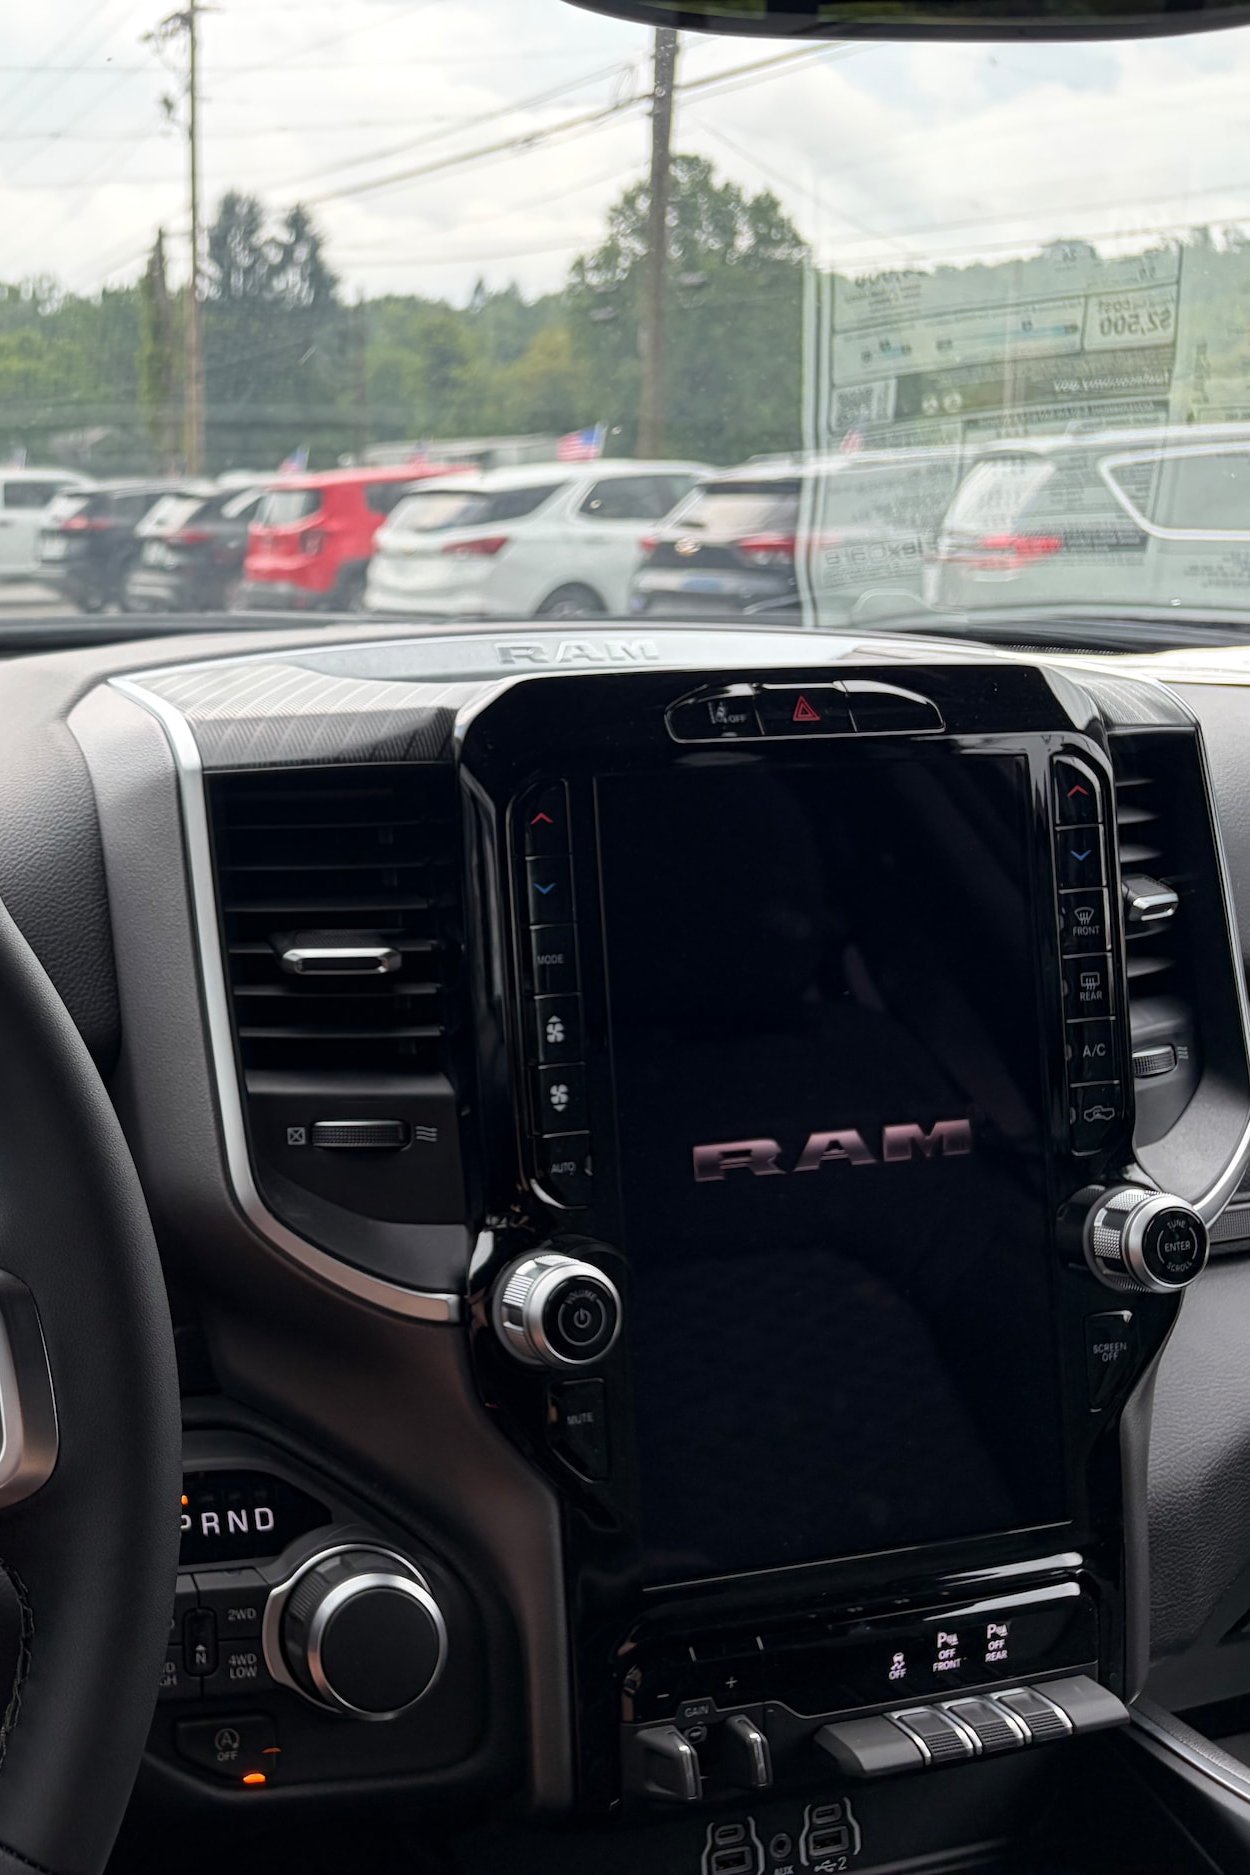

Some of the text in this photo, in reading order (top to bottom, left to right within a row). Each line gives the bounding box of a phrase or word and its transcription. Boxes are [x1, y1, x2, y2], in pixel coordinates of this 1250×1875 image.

[494, 639, 660, 665] RAM
[1072, 926, 1100, 937] FRONT
[537, 953, 564, 965] MODE
[1080, 991, 1103, 1002] REAR
[1082, 1043, 1106, 1058] A/C
[693, 1119, 972, 1182] RAM
[551, 1161, 575, 1174] AUTO
[1166, 1219, 1187, 1229] TUNE
[1164, 1241, 1191, 1252] ENTER
[1166, 1260, 1193, 1272] SCROLL
[1093, 1342, 1127, 1355] SCREEN
[1102, 1353, 1118, 1363] OFF
[567, 1411, 594, 1425] MUTE
[227, 1608, 257, 1621] 2WD
[988, 1639, 1005, 1651] OFF
[196, 1652, 206, 1665] N
[228, 1653, 257, 1665] 4WD
[938, 1648, 956, 1660] OFF
[985, 1650, 1008, 1662] REAR
[933, 1658, 962, 1673] FRONT
[229, 1666, 258, 1679] LOW
[888, 1668, 907, 1680] OFF
[684, 1705, 709, 1718] GAIN
[216, 1751, 238, 1761] OFF
[838, 1856, 847, 1871] 2
